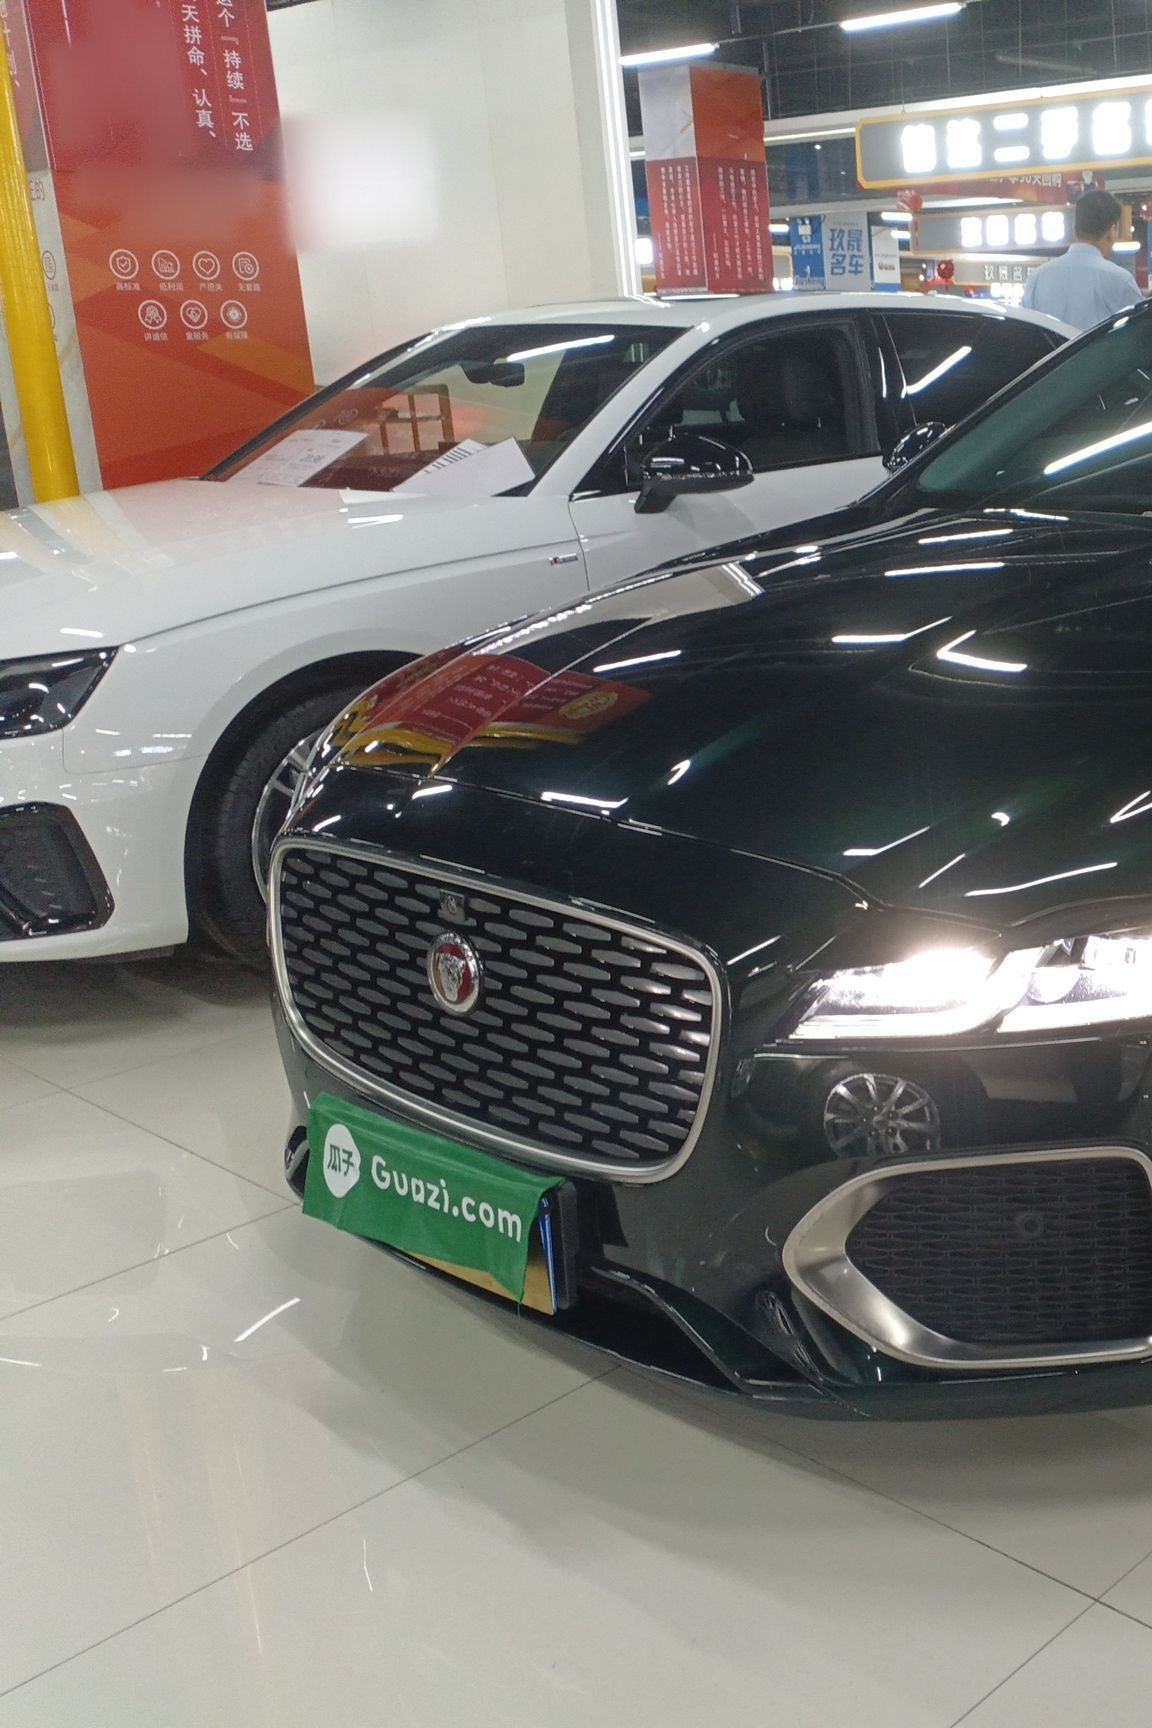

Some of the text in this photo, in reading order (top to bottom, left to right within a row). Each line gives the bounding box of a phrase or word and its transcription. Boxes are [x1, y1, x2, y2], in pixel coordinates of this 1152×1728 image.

[181, 0, 216, 138] 天拼命、认真、
[830, 253, 864, 276] 名车
[327, 1143, 523, 1244] 瓜子 Guazi.com
